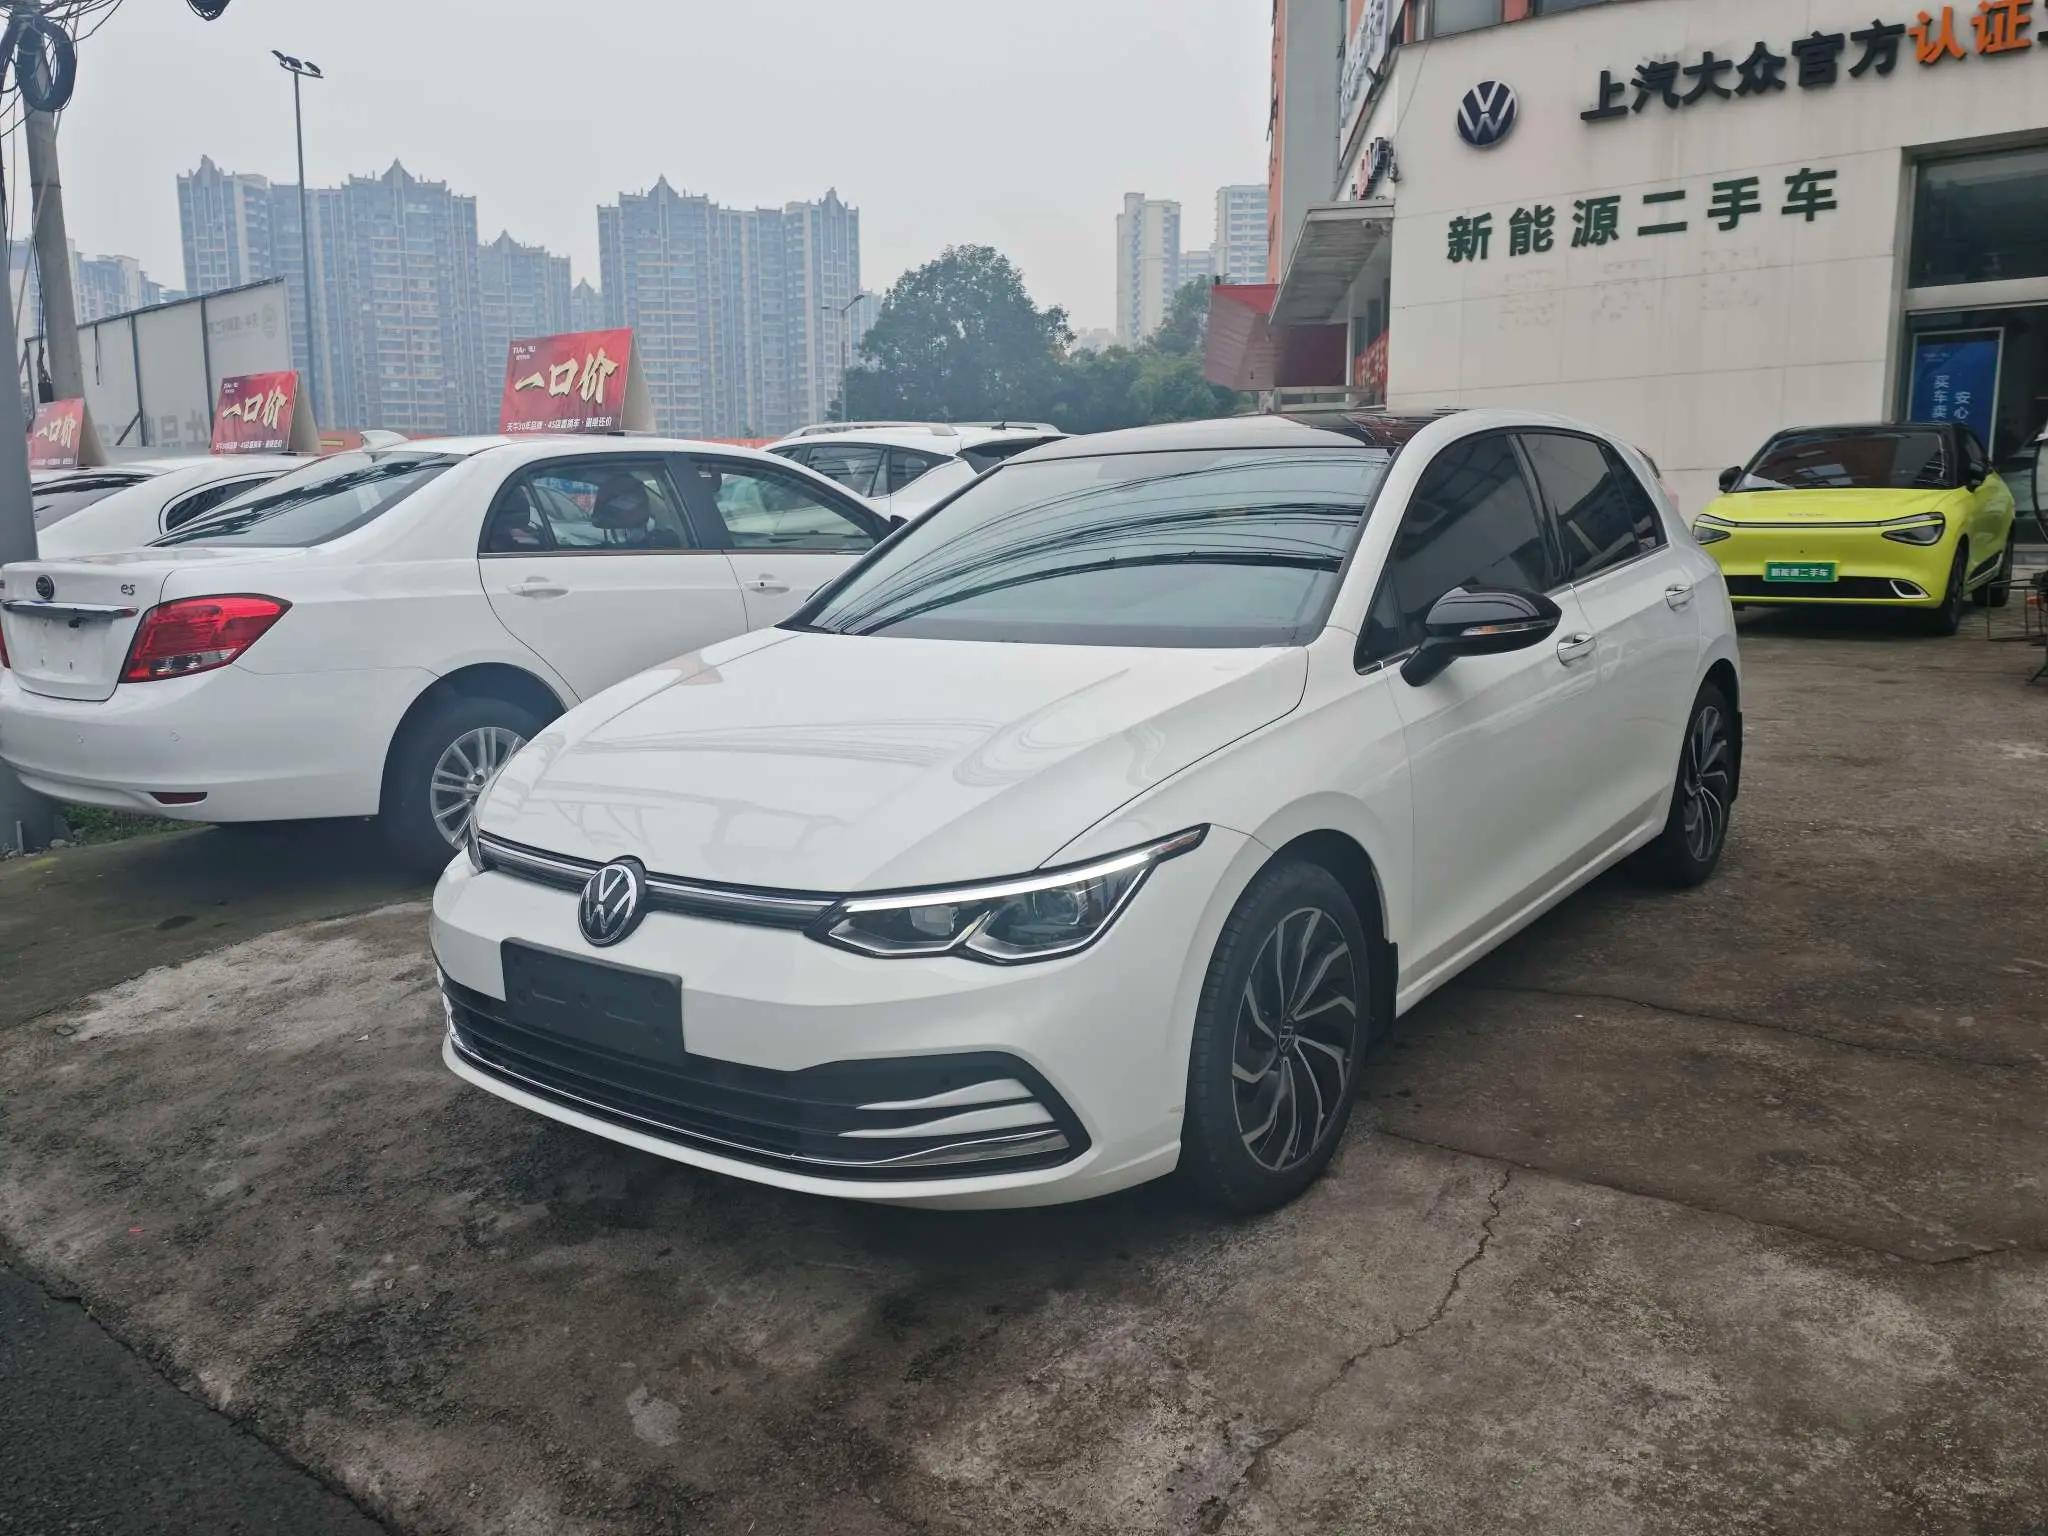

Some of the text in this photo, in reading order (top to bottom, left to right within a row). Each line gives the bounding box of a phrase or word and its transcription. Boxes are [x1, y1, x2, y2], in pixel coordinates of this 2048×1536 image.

[1580, 0, 2048, 121] 上汽大众官方认证
[1446, 167, 1838, 263] 新能源二手车
[222, 386, 289, 430] 一口价
[514, 347, 619, 405] 一口价
